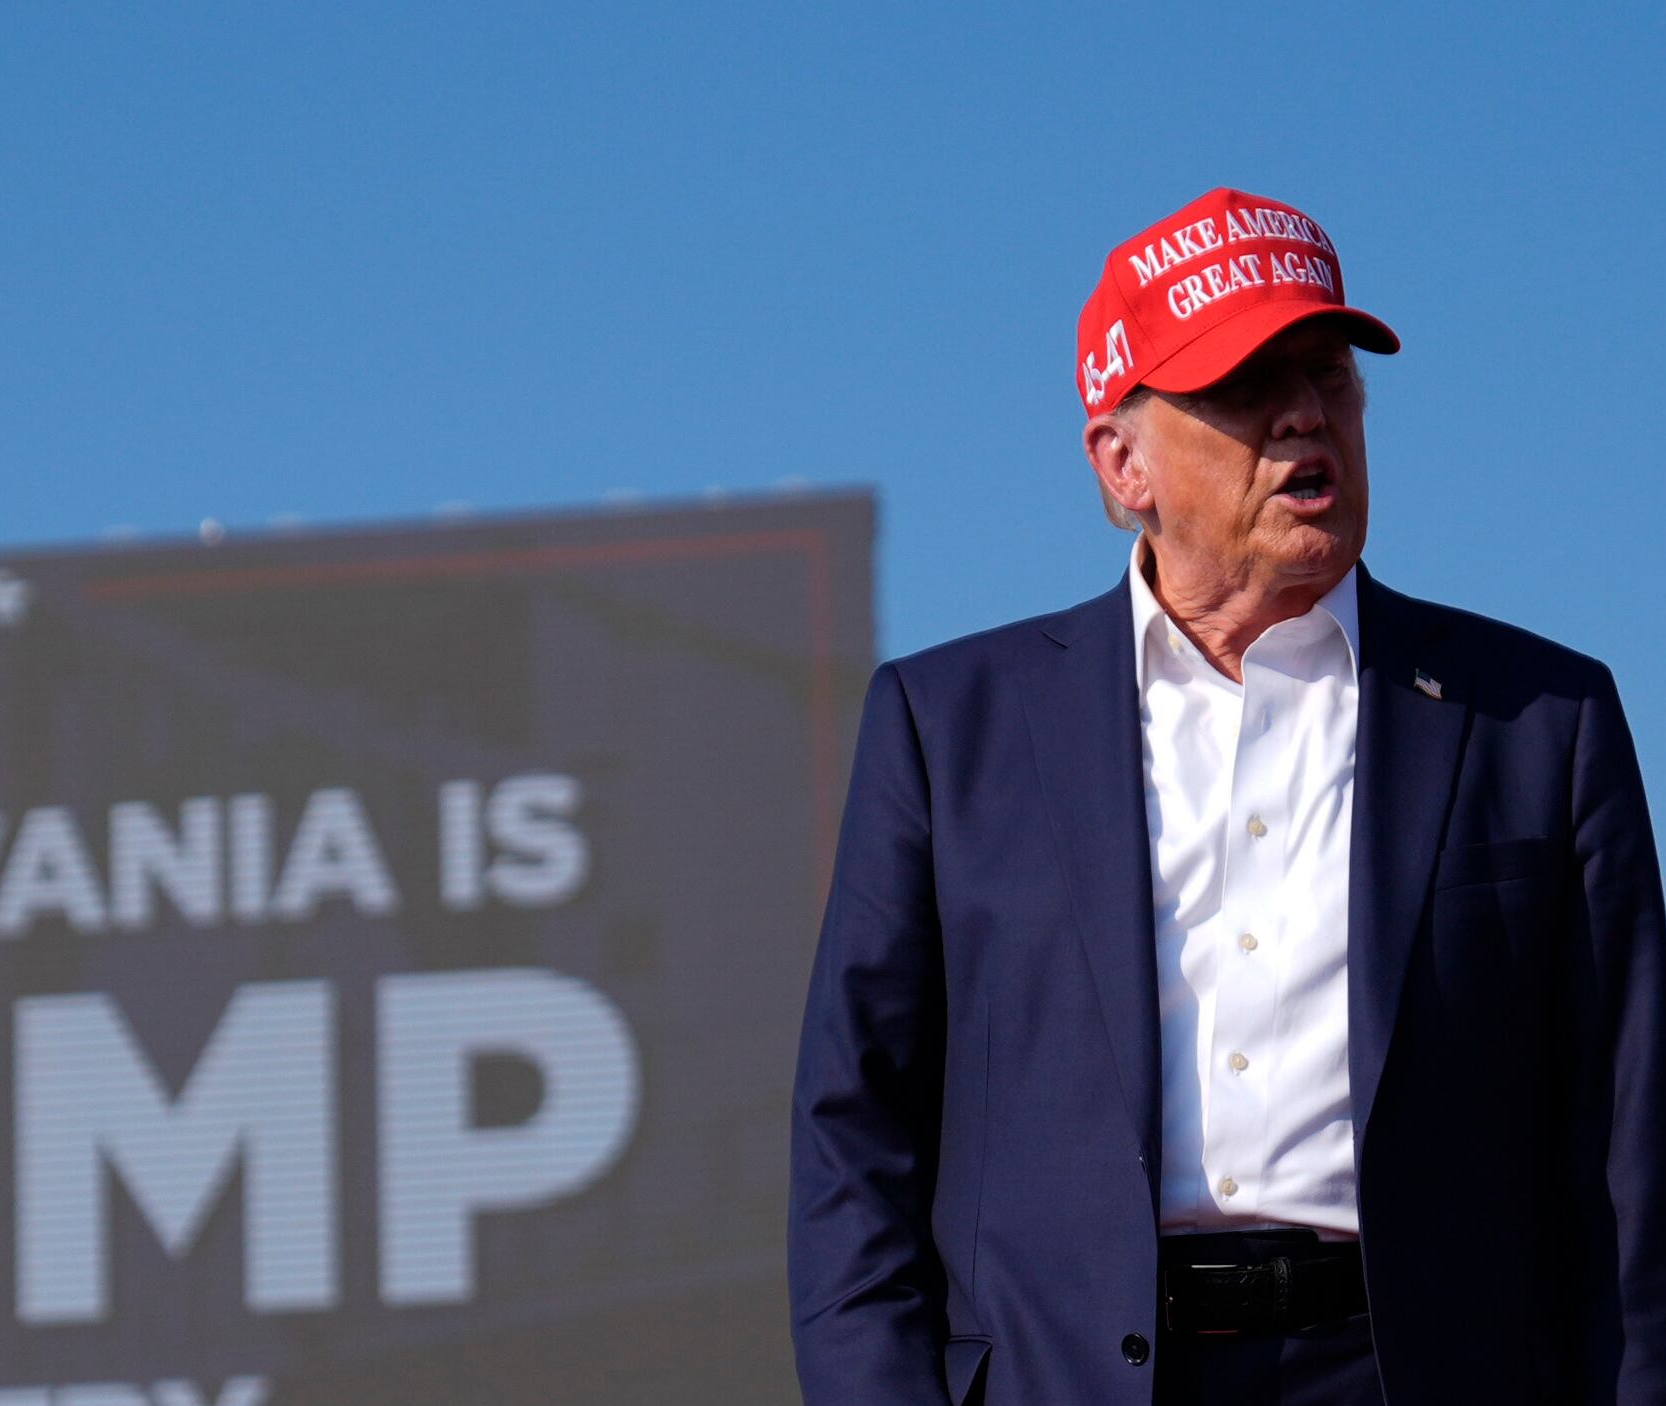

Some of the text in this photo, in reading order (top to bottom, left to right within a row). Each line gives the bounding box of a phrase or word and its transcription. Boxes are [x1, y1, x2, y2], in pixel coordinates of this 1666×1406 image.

[1128, 208, 1335, 288] MAKE AMERICA
[1167, 254, 1266, 320] GREAT
[1082, 319, 1134, 405] 45-47
[439, 774, 586, 907] IS
